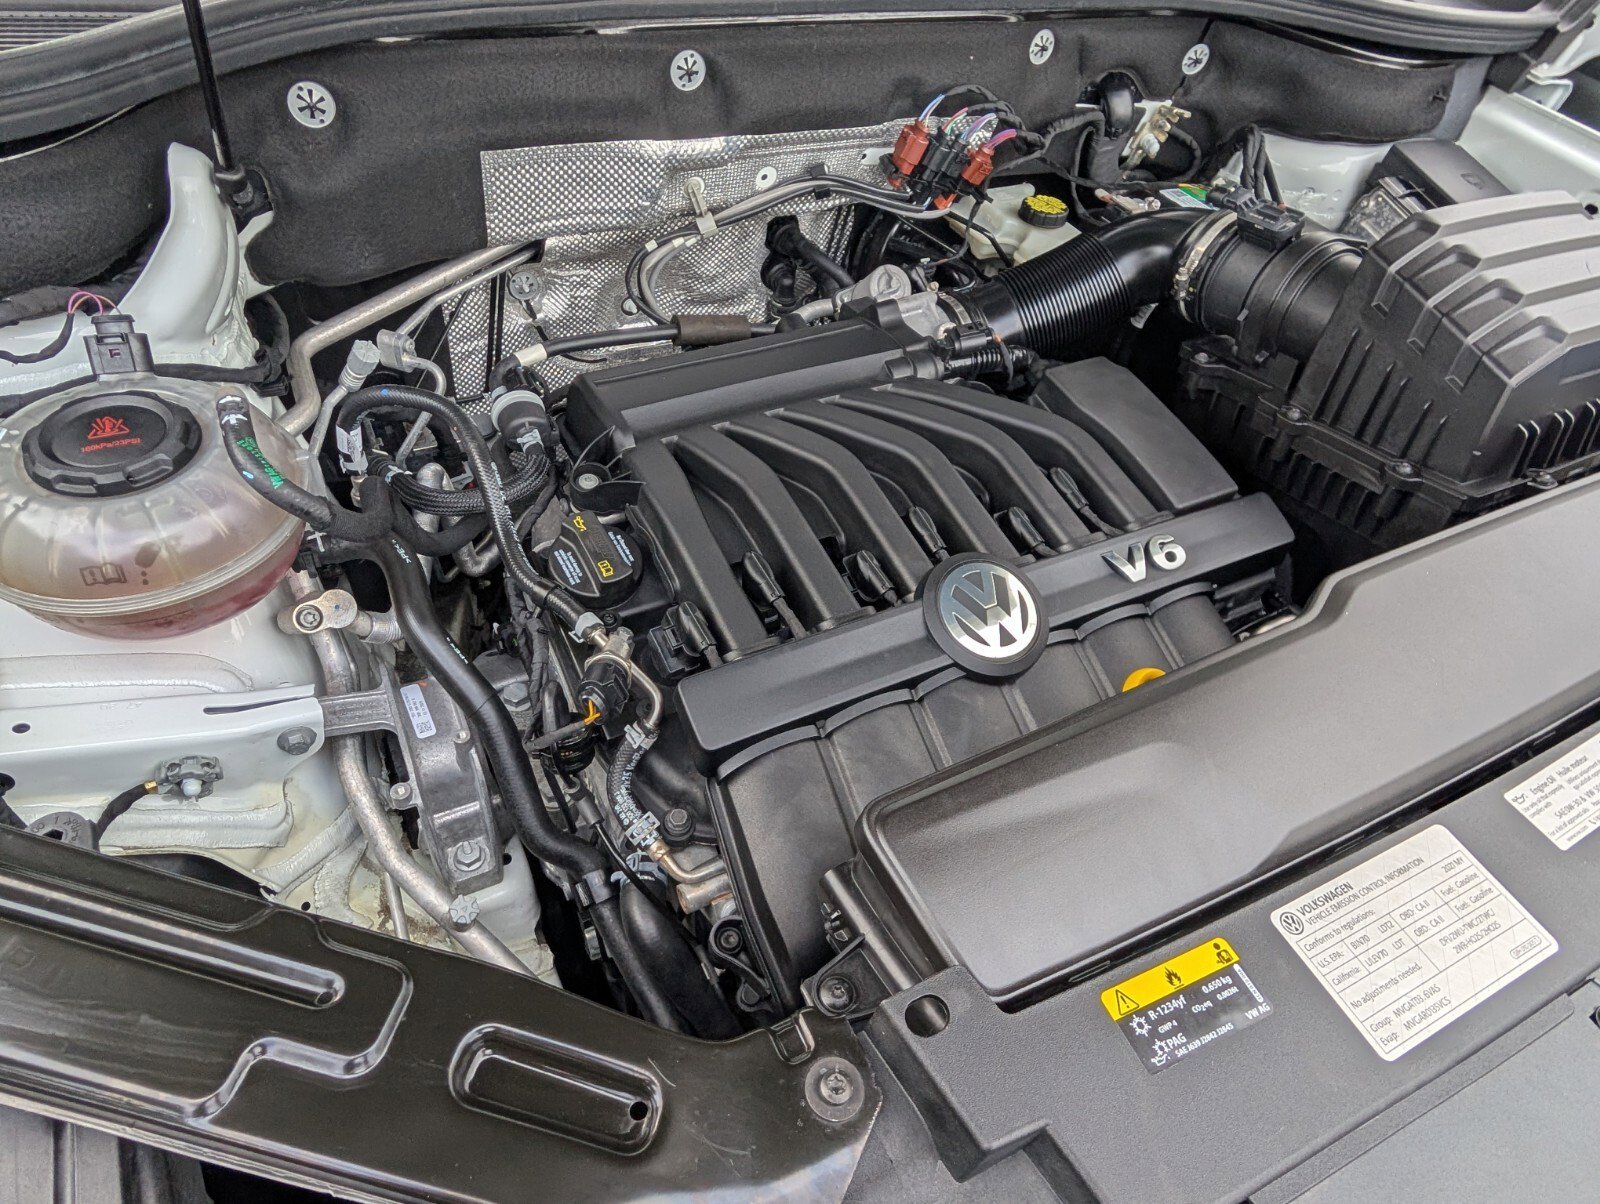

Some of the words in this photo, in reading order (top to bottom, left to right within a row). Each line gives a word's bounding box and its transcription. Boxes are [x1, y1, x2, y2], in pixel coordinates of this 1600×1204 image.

[1101, 534, 1186, 583] V6
[1455, 873, 1479, 888] Gasoline
[1296, 882, 1354, 916] VOLKSWAGEN
[1305, 908, 1333, 925] VEHICLE
[1330, 892, 1360, 912] EMISSION
[1358, 878, 1387, 897] CONTROL
[1384, 857, 1424, 882] INFORMATION
[1469, 888, 1493, 903] Gasoline
[1377, 920, 1394, 934] LDT2
[1304, 932, 1334, 951] Conforms
[1333, 928, 1341, 936] to
[1392, 938, 1405, 950] LDT
[1202, 978, 1222, 993] 0.650
[1220, 976, 1232, 984] kg
[1350, 1000, 1362, 1010] No
[1361, 977, 1399, 1002] adjustments
[1148, 994, 1186, 1020] R-1234yf
[1245, 1008, 1259, 1019] VW
[1258, 1003, 1270, 1014] AG
[1158, 1022, 1172, 1034] GWP
[1370, 1017, 1393, 1032] Group:
[1166, 1033, 1187, 1049] PAG
[1380, 1032, 1400, 1046] Evap:
[1175, 1046, 1188, 1058] SAE
